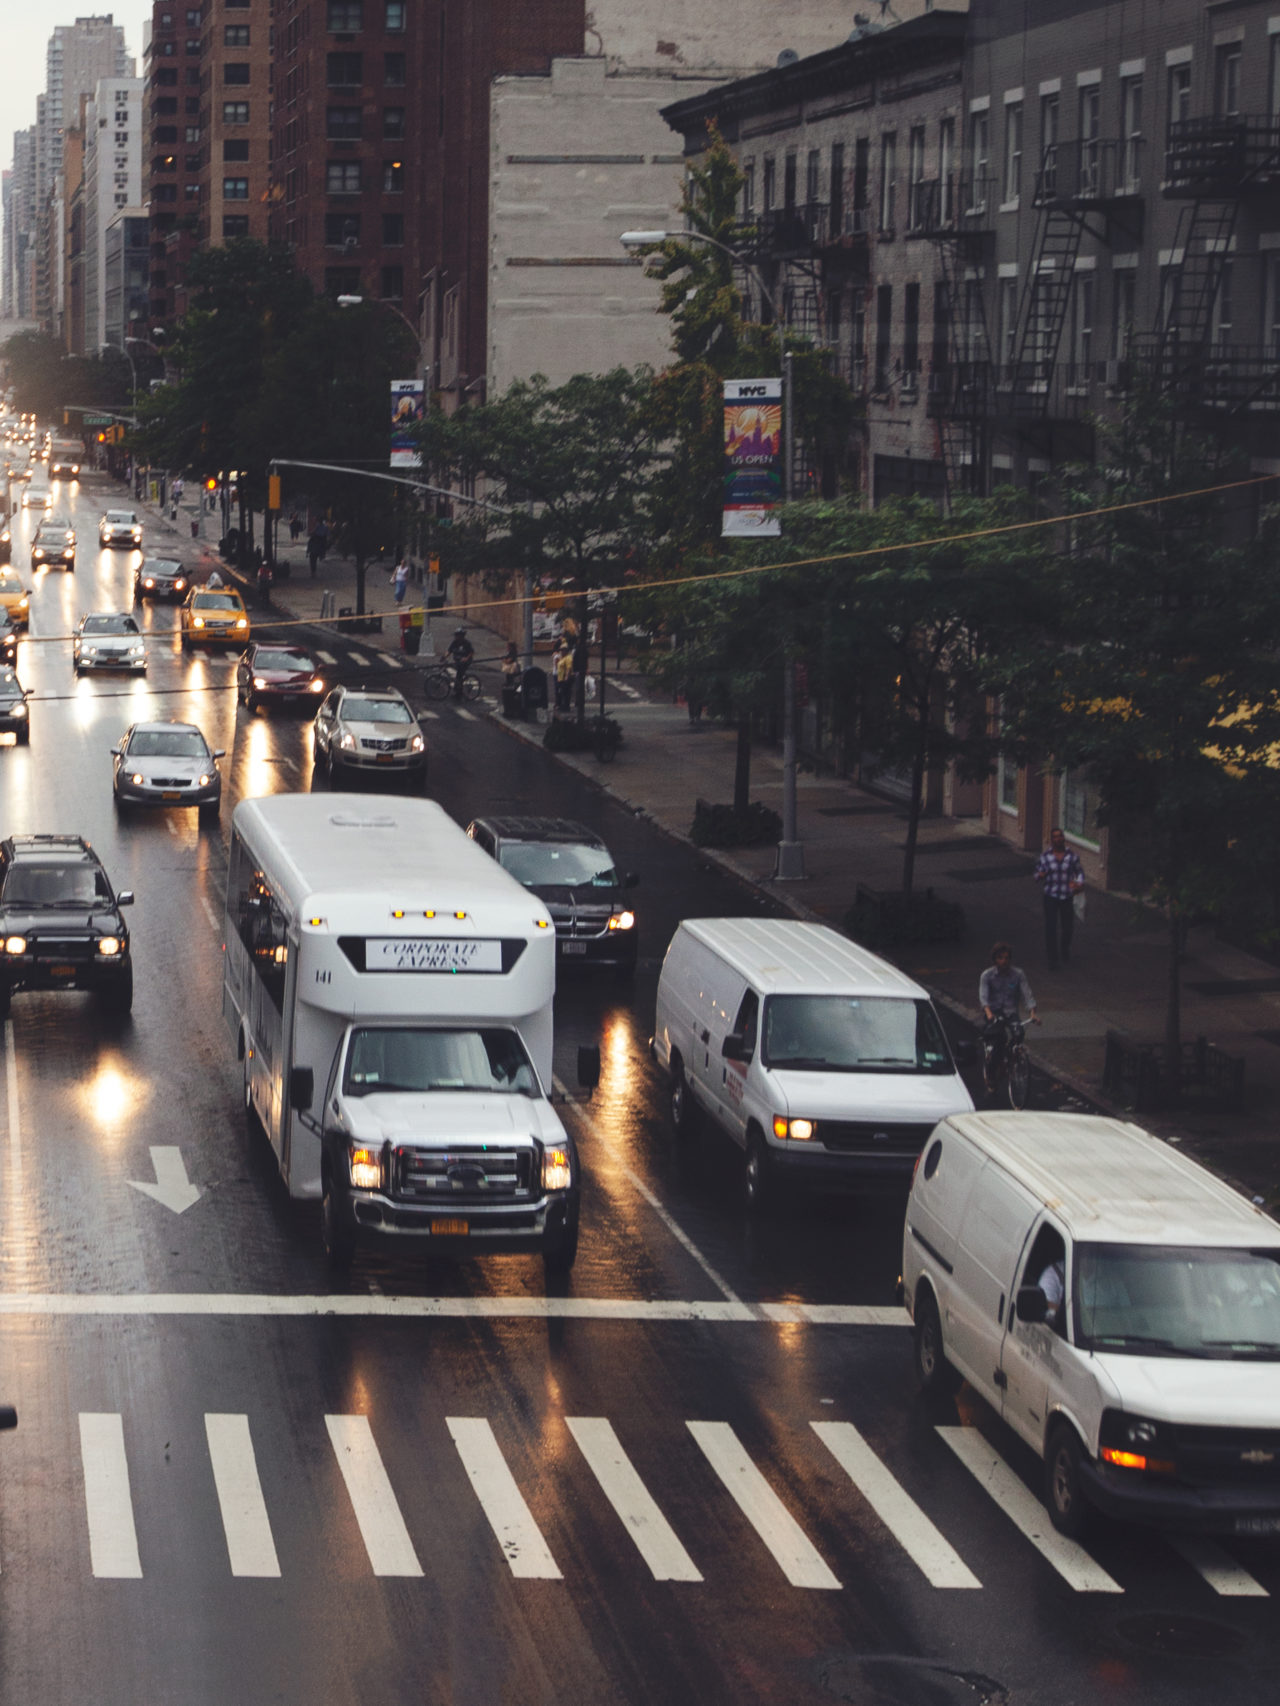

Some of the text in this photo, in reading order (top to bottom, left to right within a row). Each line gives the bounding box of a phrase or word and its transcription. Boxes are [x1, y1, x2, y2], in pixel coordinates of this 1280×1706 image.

[738, 385, 767, 397] NYC
[731, 454, 773, 465] US OPEN
[382, 943, 482, 955] CORPORATE
[397, 955, 471, 967] EXPRESS
[315, 969, 332, 984] 141
